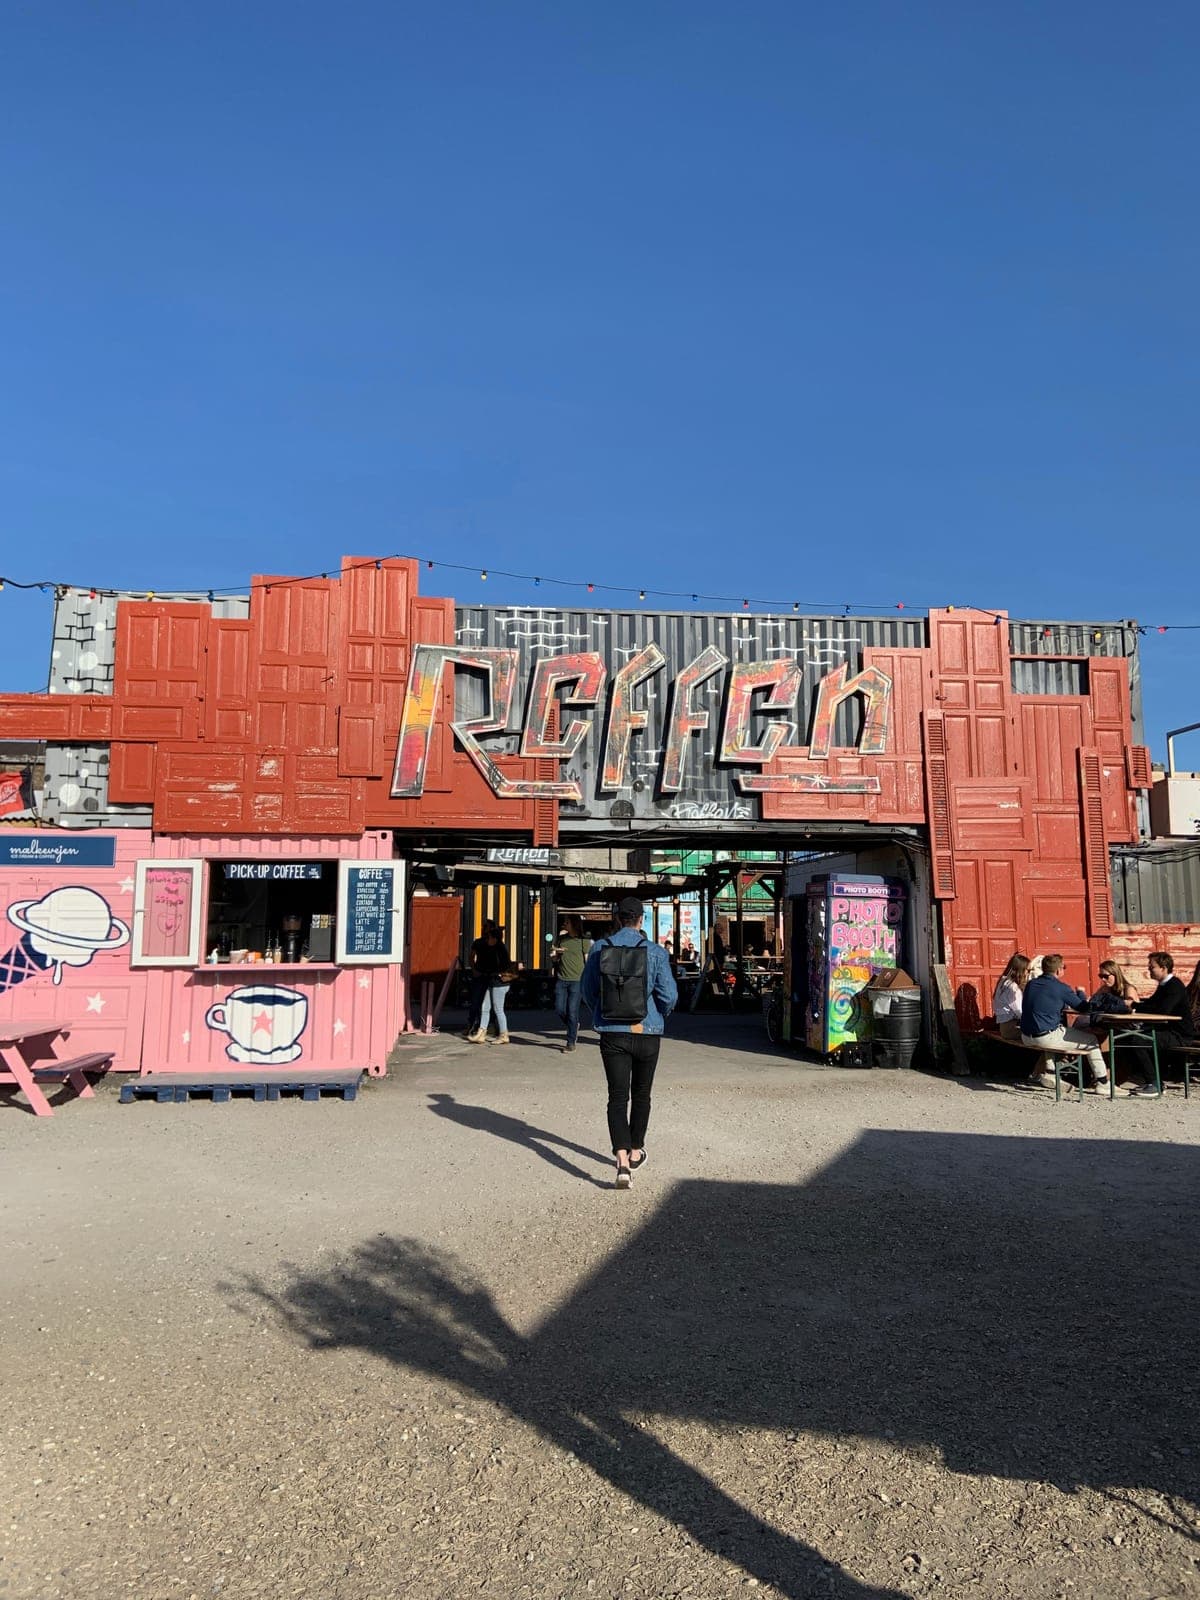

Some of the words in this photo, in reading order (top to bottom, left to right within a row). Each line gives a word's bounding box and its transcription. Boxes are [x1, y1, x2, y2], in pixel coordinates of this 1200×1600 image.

[230, 864, 270, 879] PICK-UP
[273, 864, 306, 879] COFFEE
[359, 868, 383, 880] COFFEE
[844, 886, 867, 894] PHOTO
[832, 898, 901, 924] PHOTO
[832, 922, 896, 951] BOOTH
